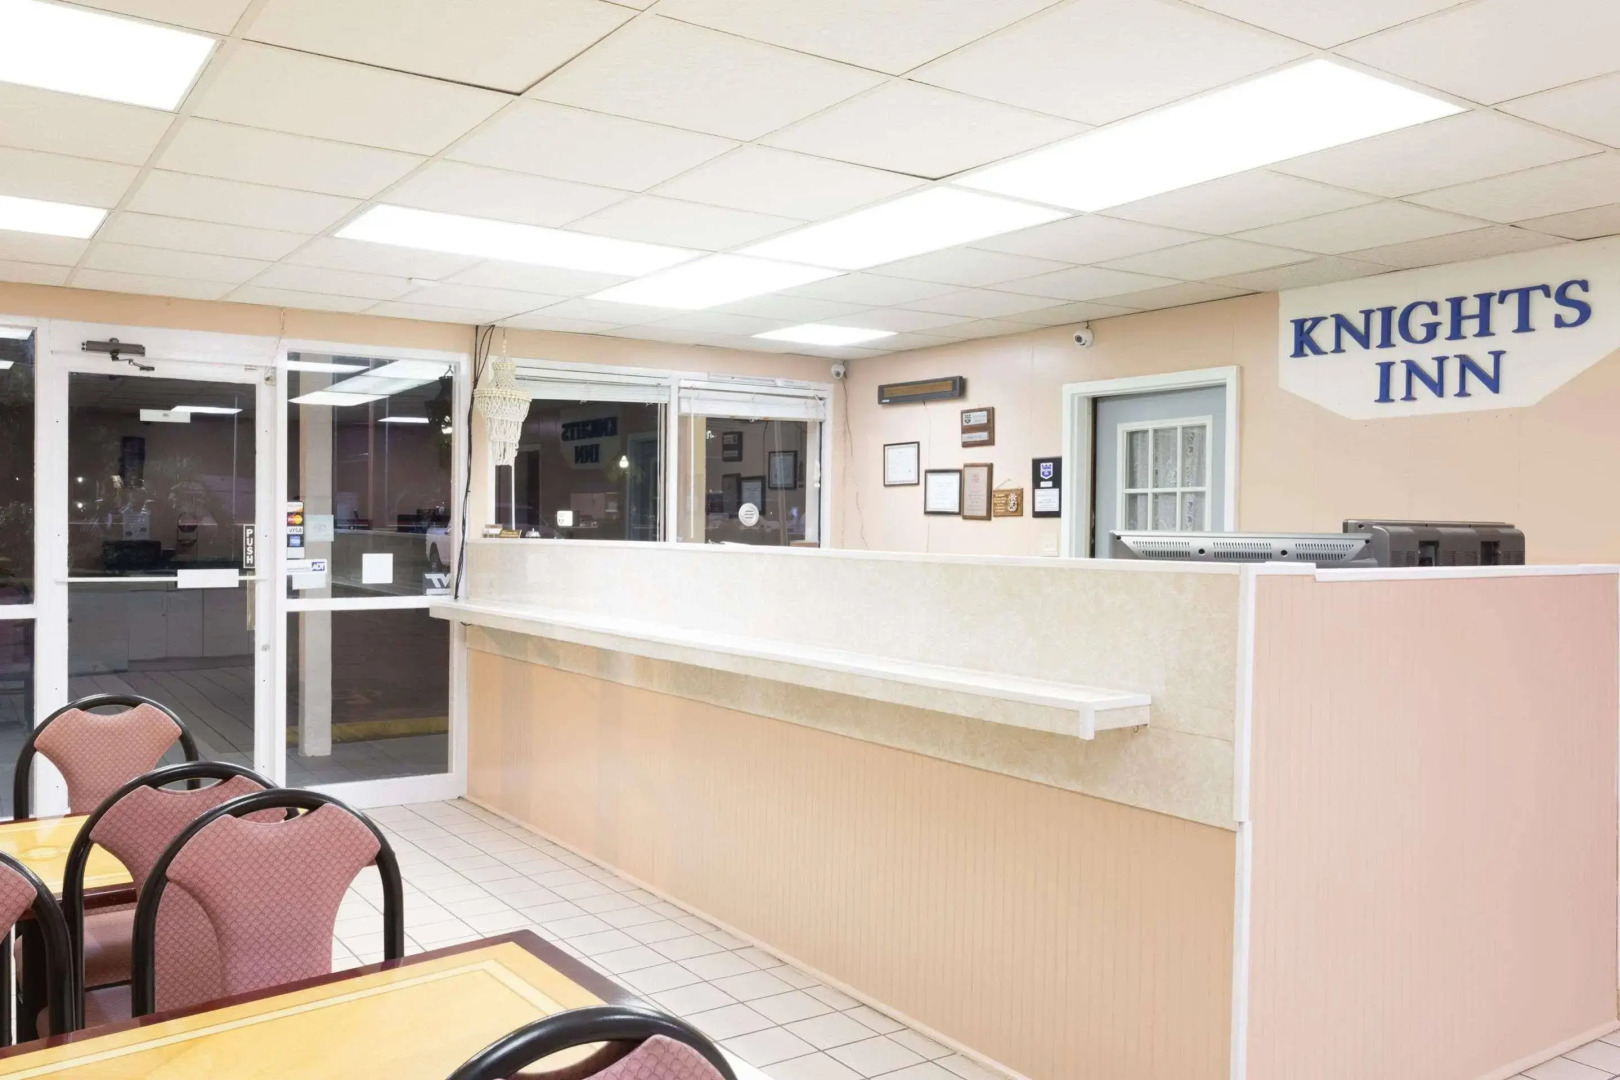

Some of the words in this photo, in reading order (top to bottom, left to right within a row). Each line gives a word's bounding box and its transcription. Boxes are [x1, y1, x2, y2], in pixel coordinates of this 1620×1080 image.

[1289, 279, 1593, 358] KNIGHTS
[1374, 350, 1507, 403] INN
[312, 562, 325, 571] ADT
